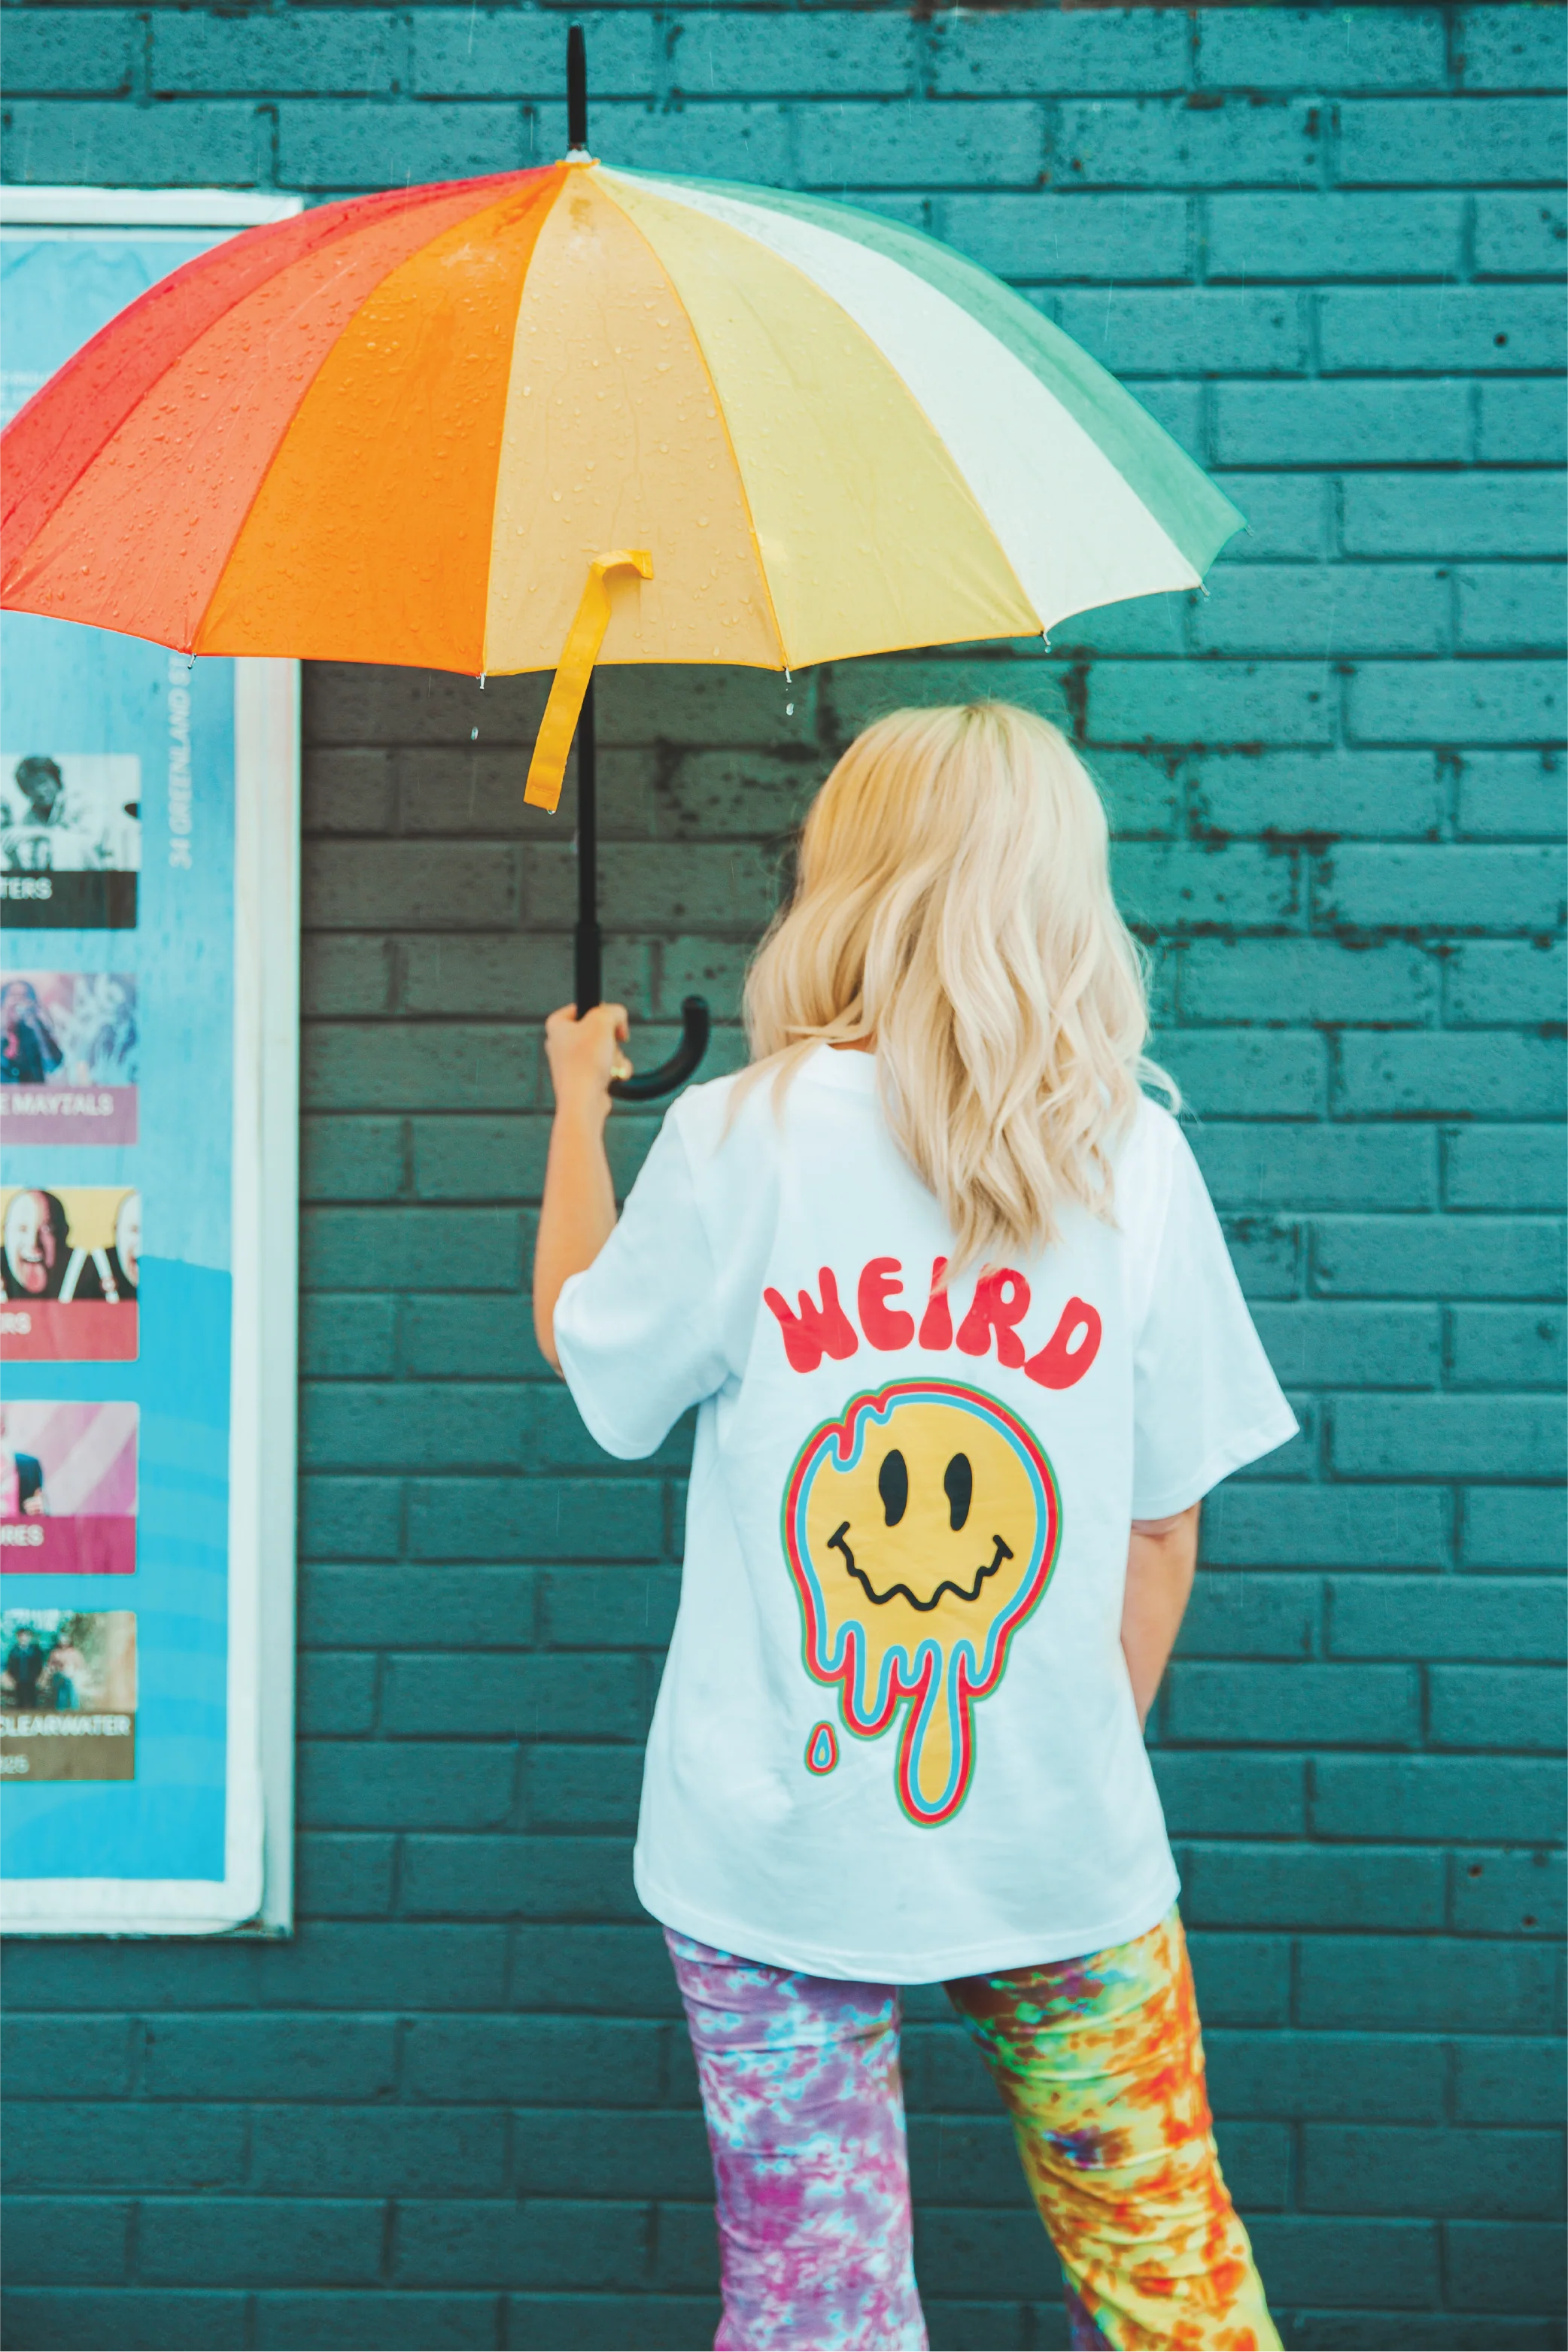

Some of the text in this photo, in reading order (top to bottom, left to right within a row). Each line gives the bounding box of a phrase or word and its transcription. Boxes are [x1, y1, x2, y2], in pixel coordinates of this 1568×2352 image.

[168, 688, 192, 835] GREENLAND
[11, 1093, 114, 1117] MAYTALS
[0, 1312, 32, 1335] RS
[763, 1256, 1103, 1390] WEIRD
